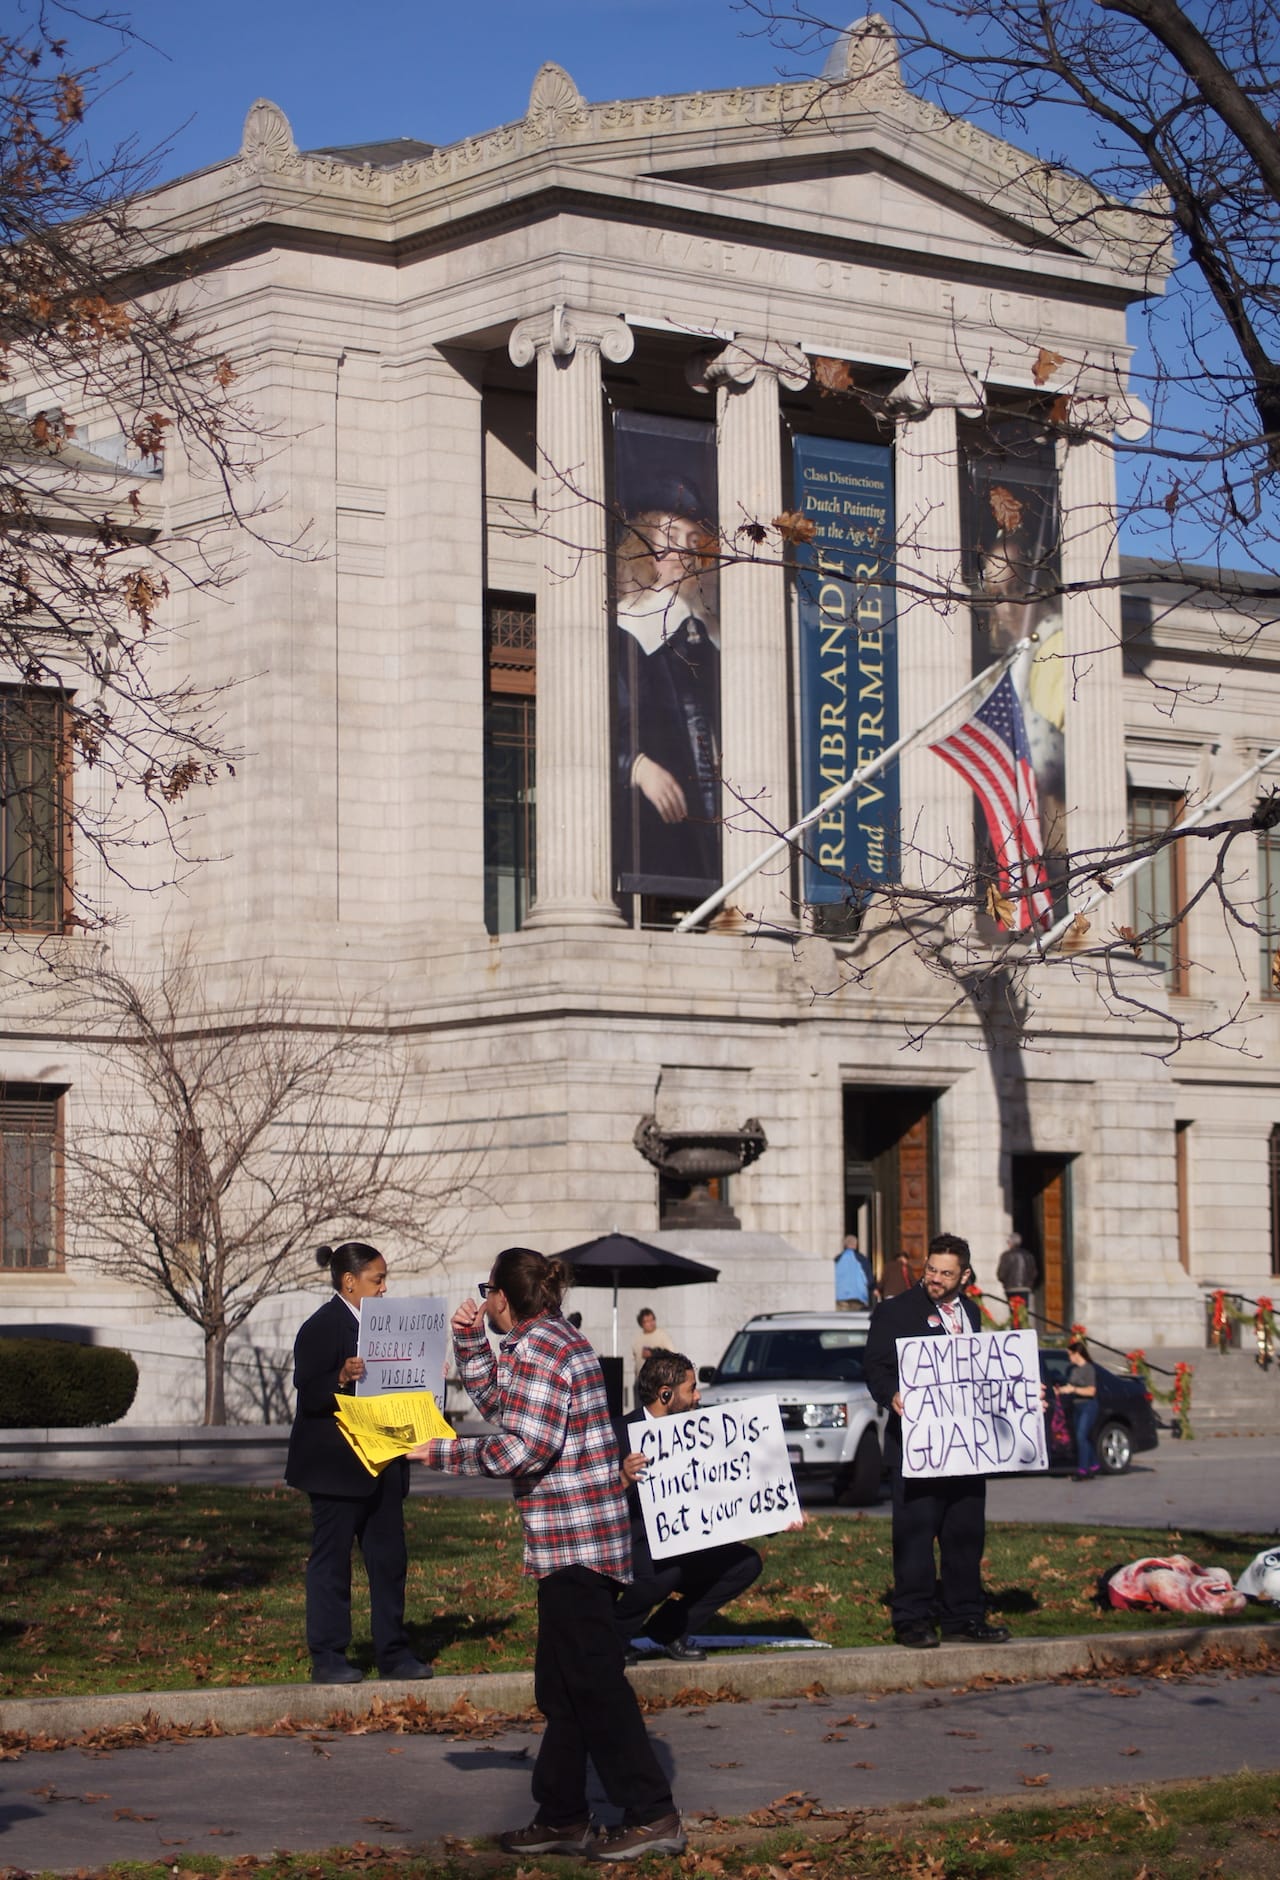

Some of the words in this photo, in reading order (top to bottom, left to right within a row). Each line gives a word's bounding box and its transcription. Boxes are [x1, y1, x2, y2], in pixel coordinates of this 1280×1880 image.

[803, 467, 828, 481] Class
[829, 471, 885, 490] Distinctions
[806, 495, 840, 513] Dutch
[843, 501, 886, 525] Painting
[815, 521, 825, 537] in
[828, 522, 844, 539] the
[846, 527, 865, 547] Age
[856, 558, 885, 812] VERMEER
[818, 550, 847, 871] REMBRANDT
[858, 823, 885, 874] and
[370, 1315, 391, 1333] OUR
[400, 1313, 445, 1332] VISITORS
[368, 1341, 413, 1359] DESERVE
[418, 1341, 425, 1357] A
[901, 1334, 1024, 1388] CAMERAS
[381, 1369, 425, 1385] VISIBLE
[973, 1379, 1037, 1415] REPLACE
[640, 1416, 714, 1468] CLASS
[906, 1412, 1045, 1471] GUARDS!
[656, 1504, 690, 1543] Bet
[701, 1497, 743, 1535] your
